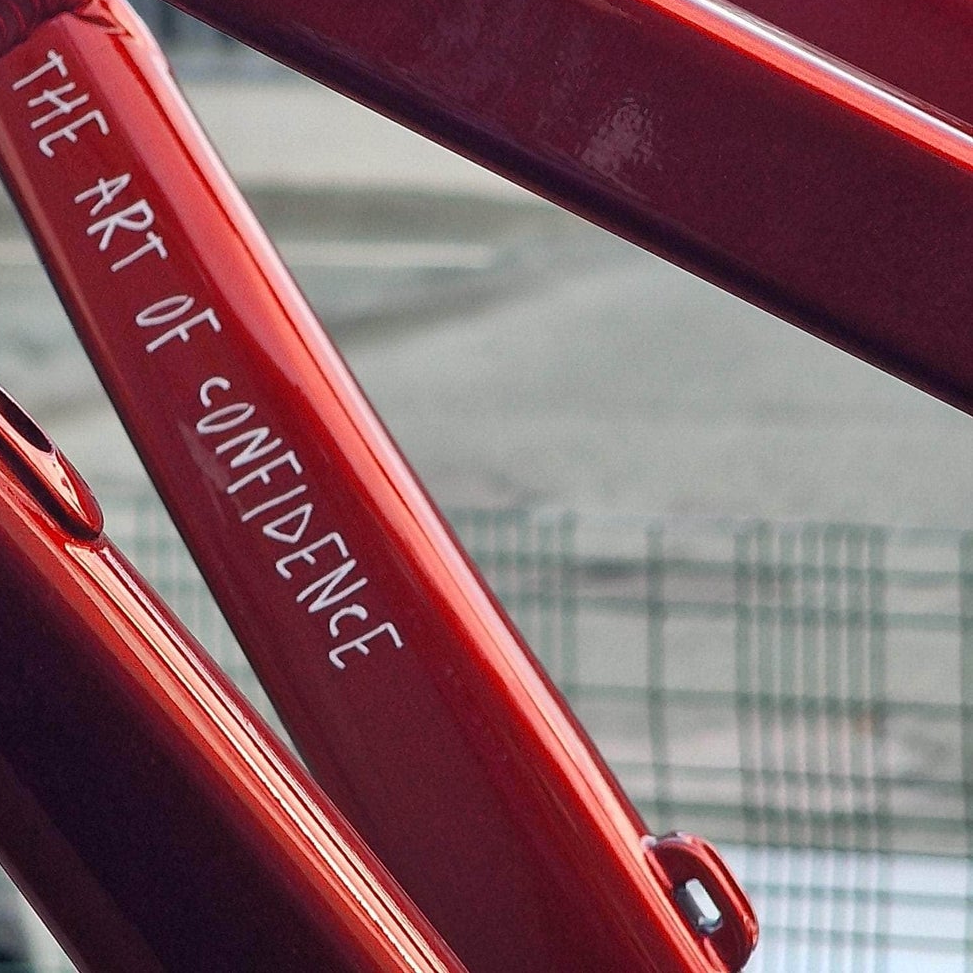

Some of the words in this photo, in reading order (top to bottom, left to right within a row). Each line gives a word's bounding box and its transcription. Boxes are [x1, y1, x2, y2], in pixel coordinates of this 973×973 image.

[13, 49, 109, 157] THE
[74, 173, 168, 272] ART
[135, 294, 221, 352] OF
[196, 376, 403, 670] CONFIDENCE
